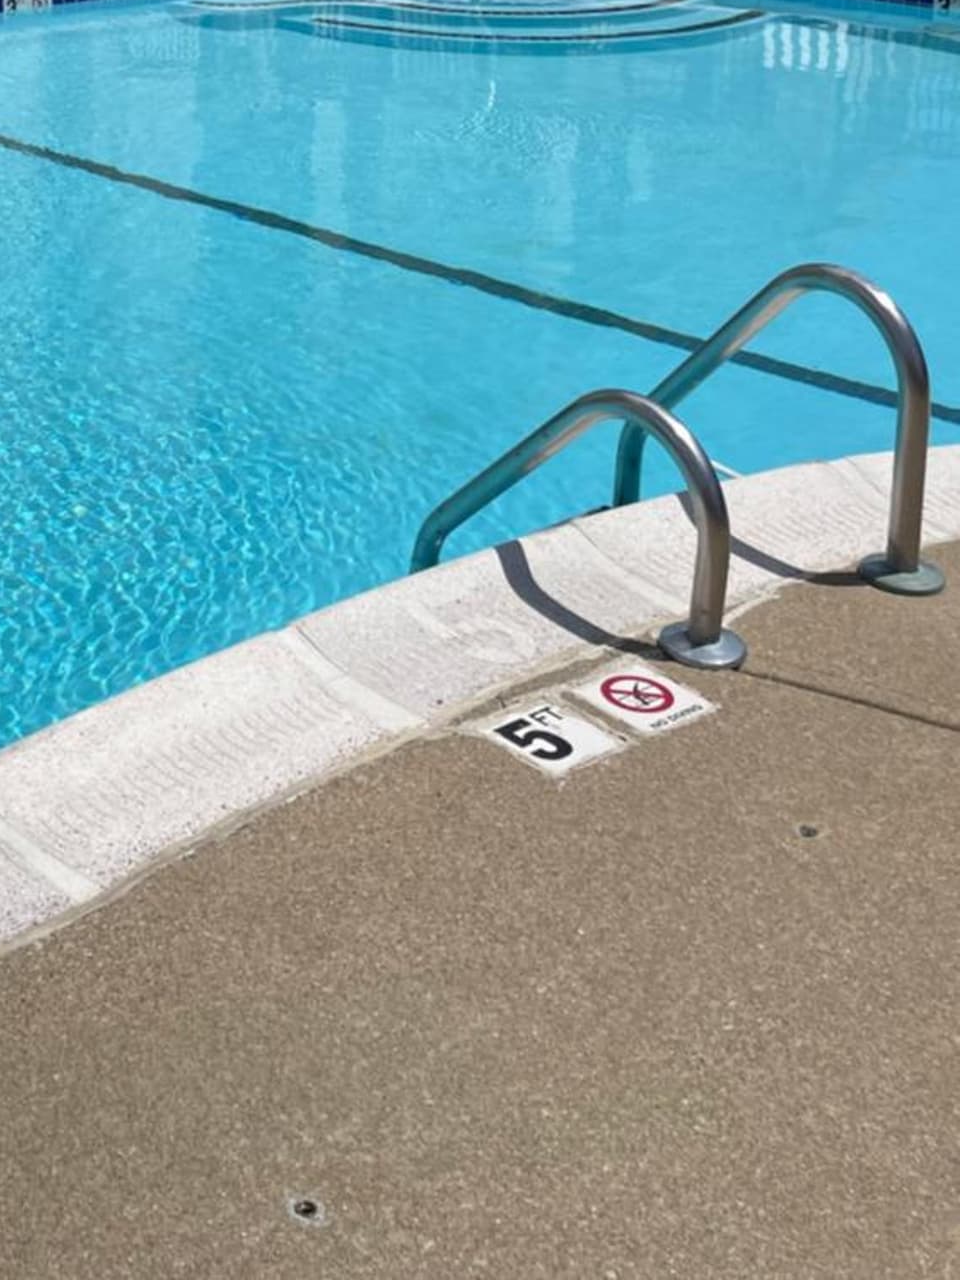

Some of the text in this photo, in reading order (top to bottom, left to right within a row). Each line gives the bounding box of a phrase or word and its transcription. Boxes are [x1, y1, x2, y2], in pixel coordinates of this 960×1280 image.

[494, 705, 573, 761] 5 FT
[650, 704, 703, 729] NO DIVING
